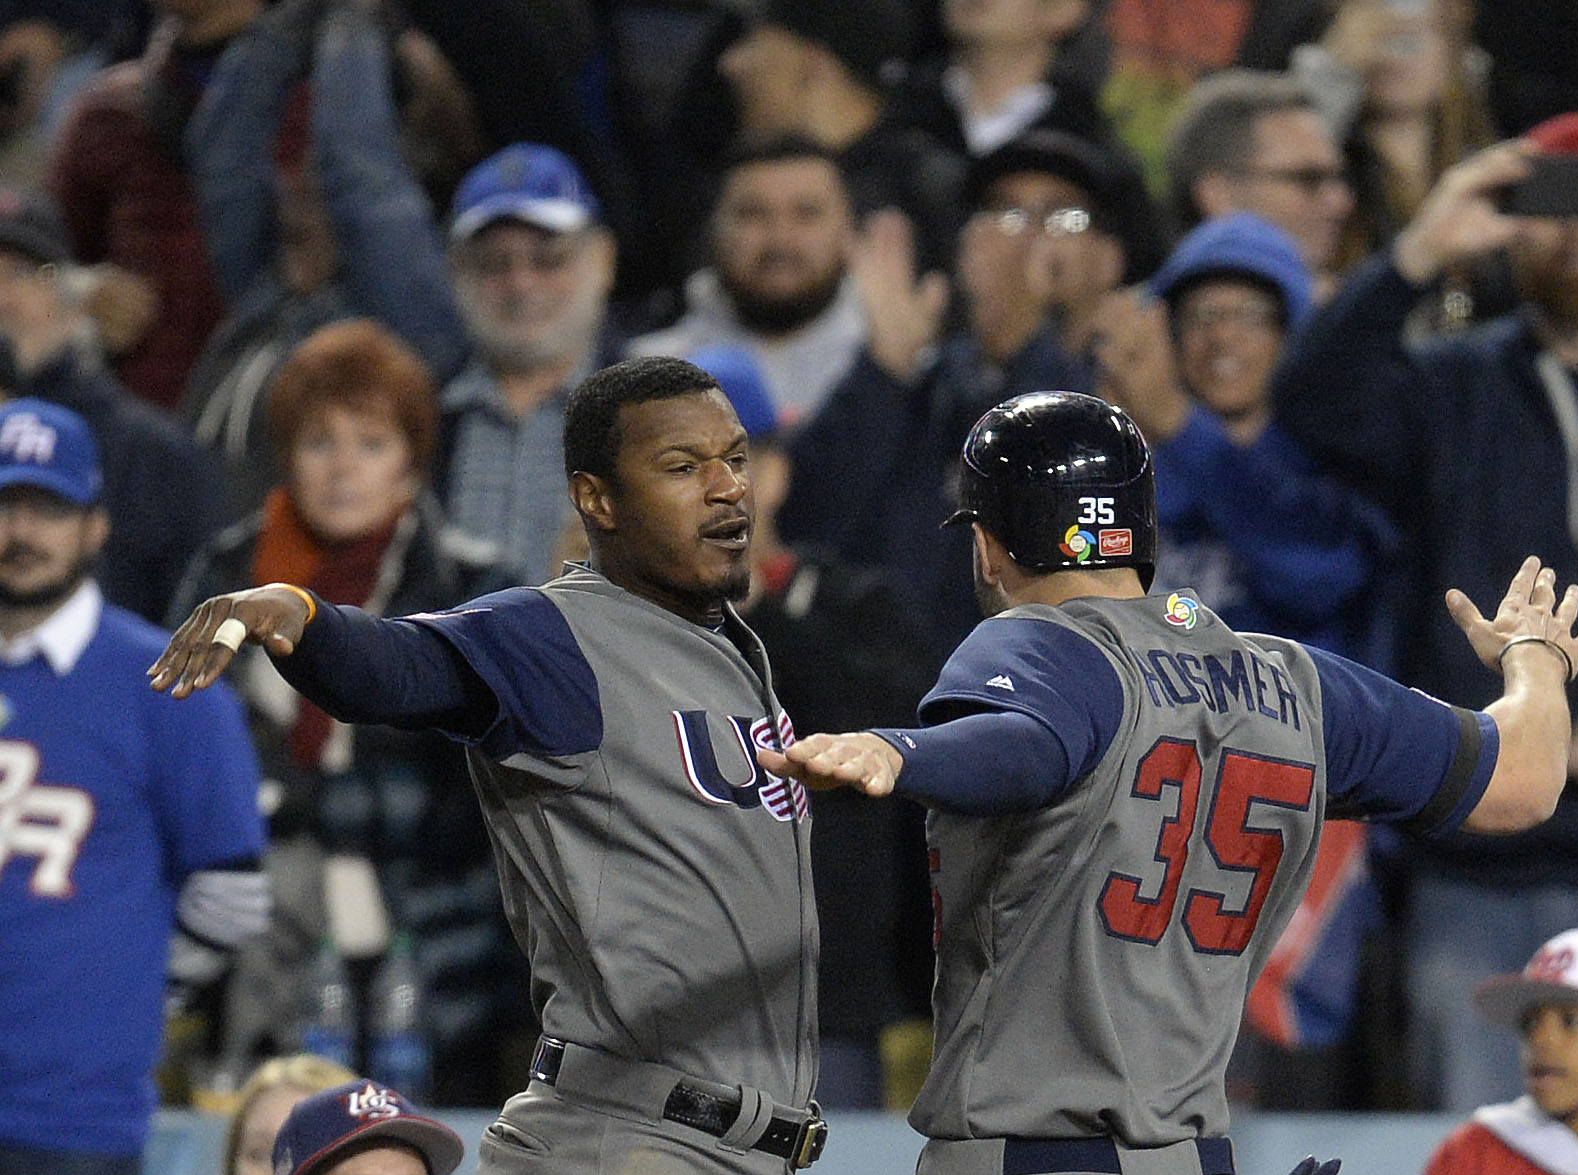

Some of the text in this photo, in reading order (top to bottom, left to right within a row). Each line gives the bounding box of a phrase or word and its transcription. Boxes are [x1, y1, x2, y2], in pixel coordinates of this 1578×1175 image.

[1077, 496, 1115, 524] 35
[1130, 646, 1301, 732] HOSMER
[1096, 735, 1316, 957] 35
